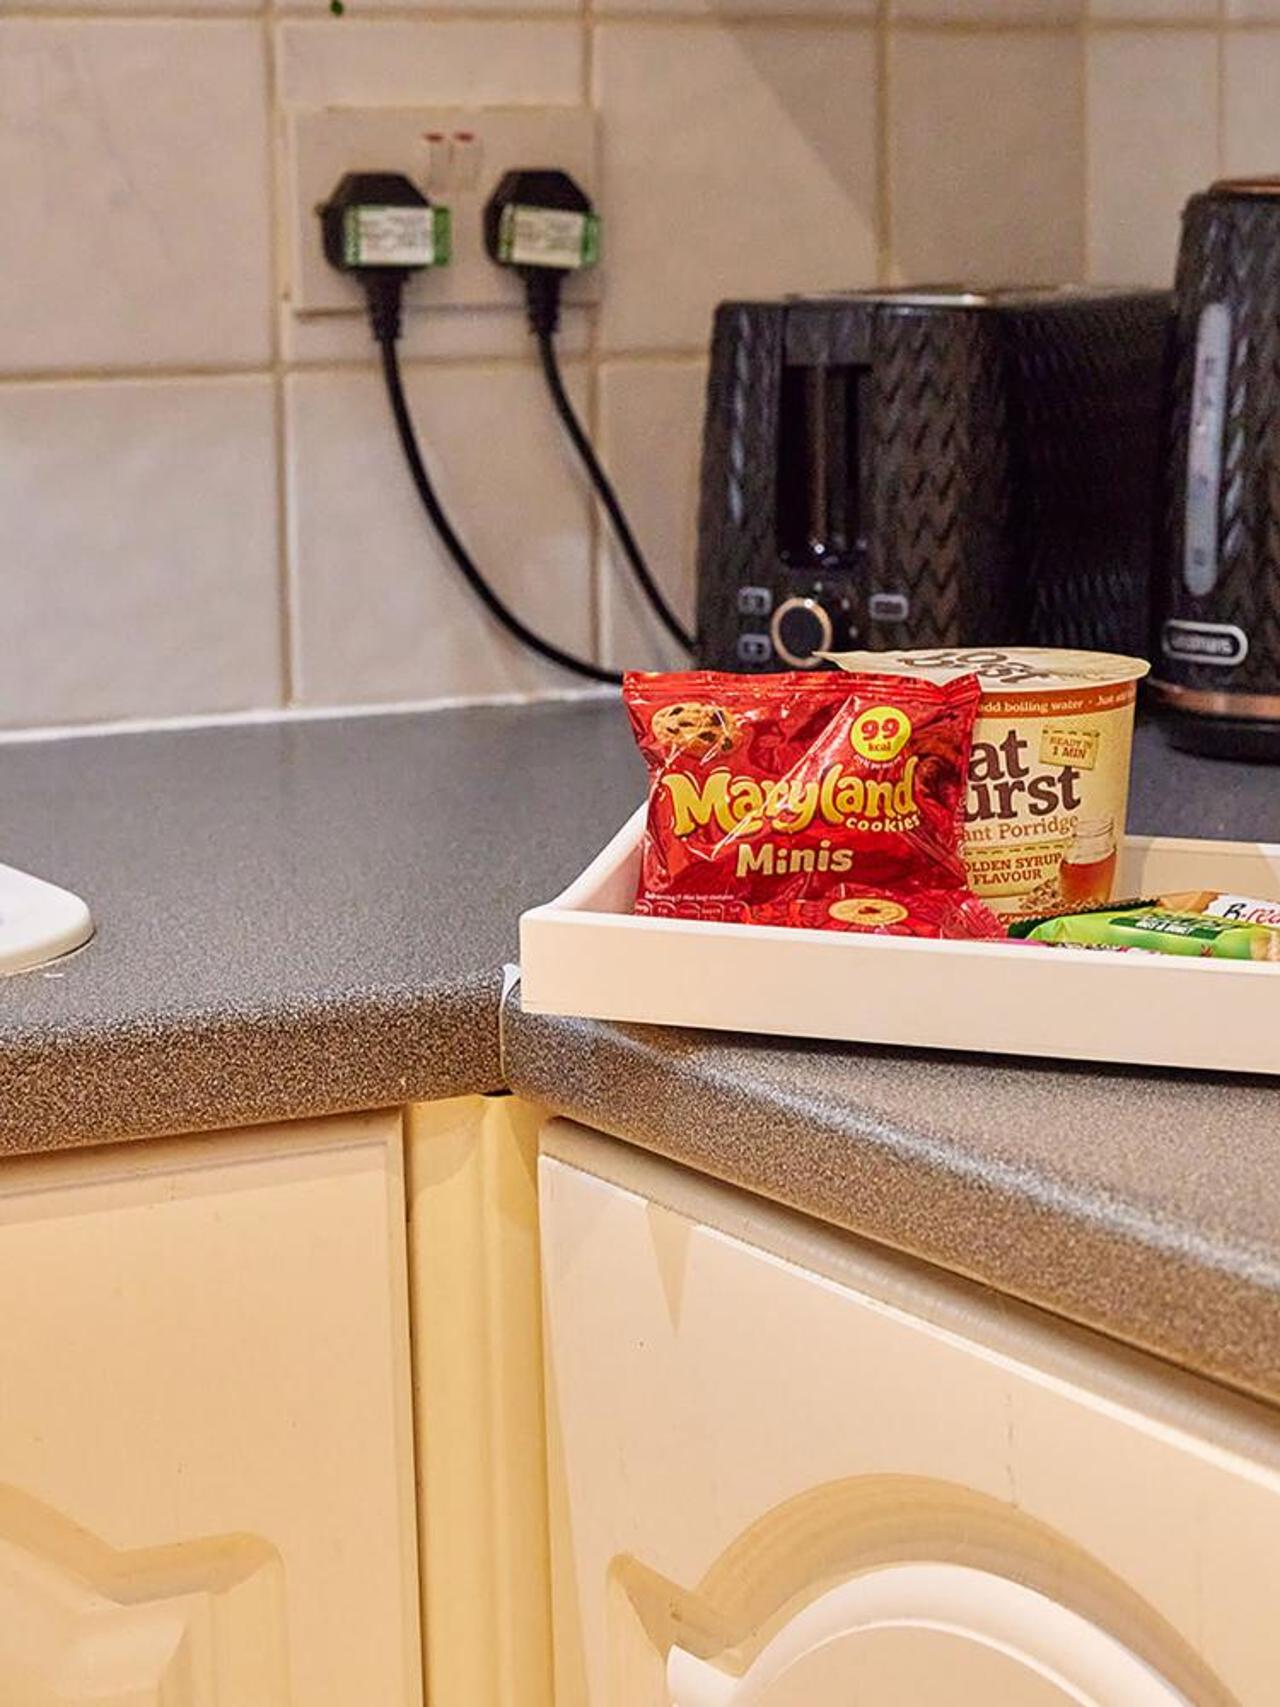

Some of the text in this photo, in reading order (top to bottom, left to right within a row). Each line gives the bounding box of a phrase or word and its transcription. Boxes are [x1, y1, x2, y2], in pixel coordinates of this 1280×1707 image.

[1004, 700, 1049, 714] boiling
[1050, 700, 1084, 712] water
[860, 717, 900, 741] 99
[867, 741, 892, 753] kcal
[967, 729, 1030, 782] at
[1061, 746, 1087, 760] MIN
[661, 756, 919, 836] Maryland
[963, 764, 1082, 823] urst
[845, 814, 921, 833] cookies
[998, 815, 1079, 839] Porridge
[736, 839, 854, 878] Minis
[961, 851, 1063, 873] OLDEN SYRUP
[973, 868, 1042, 885] FLAVOUR
